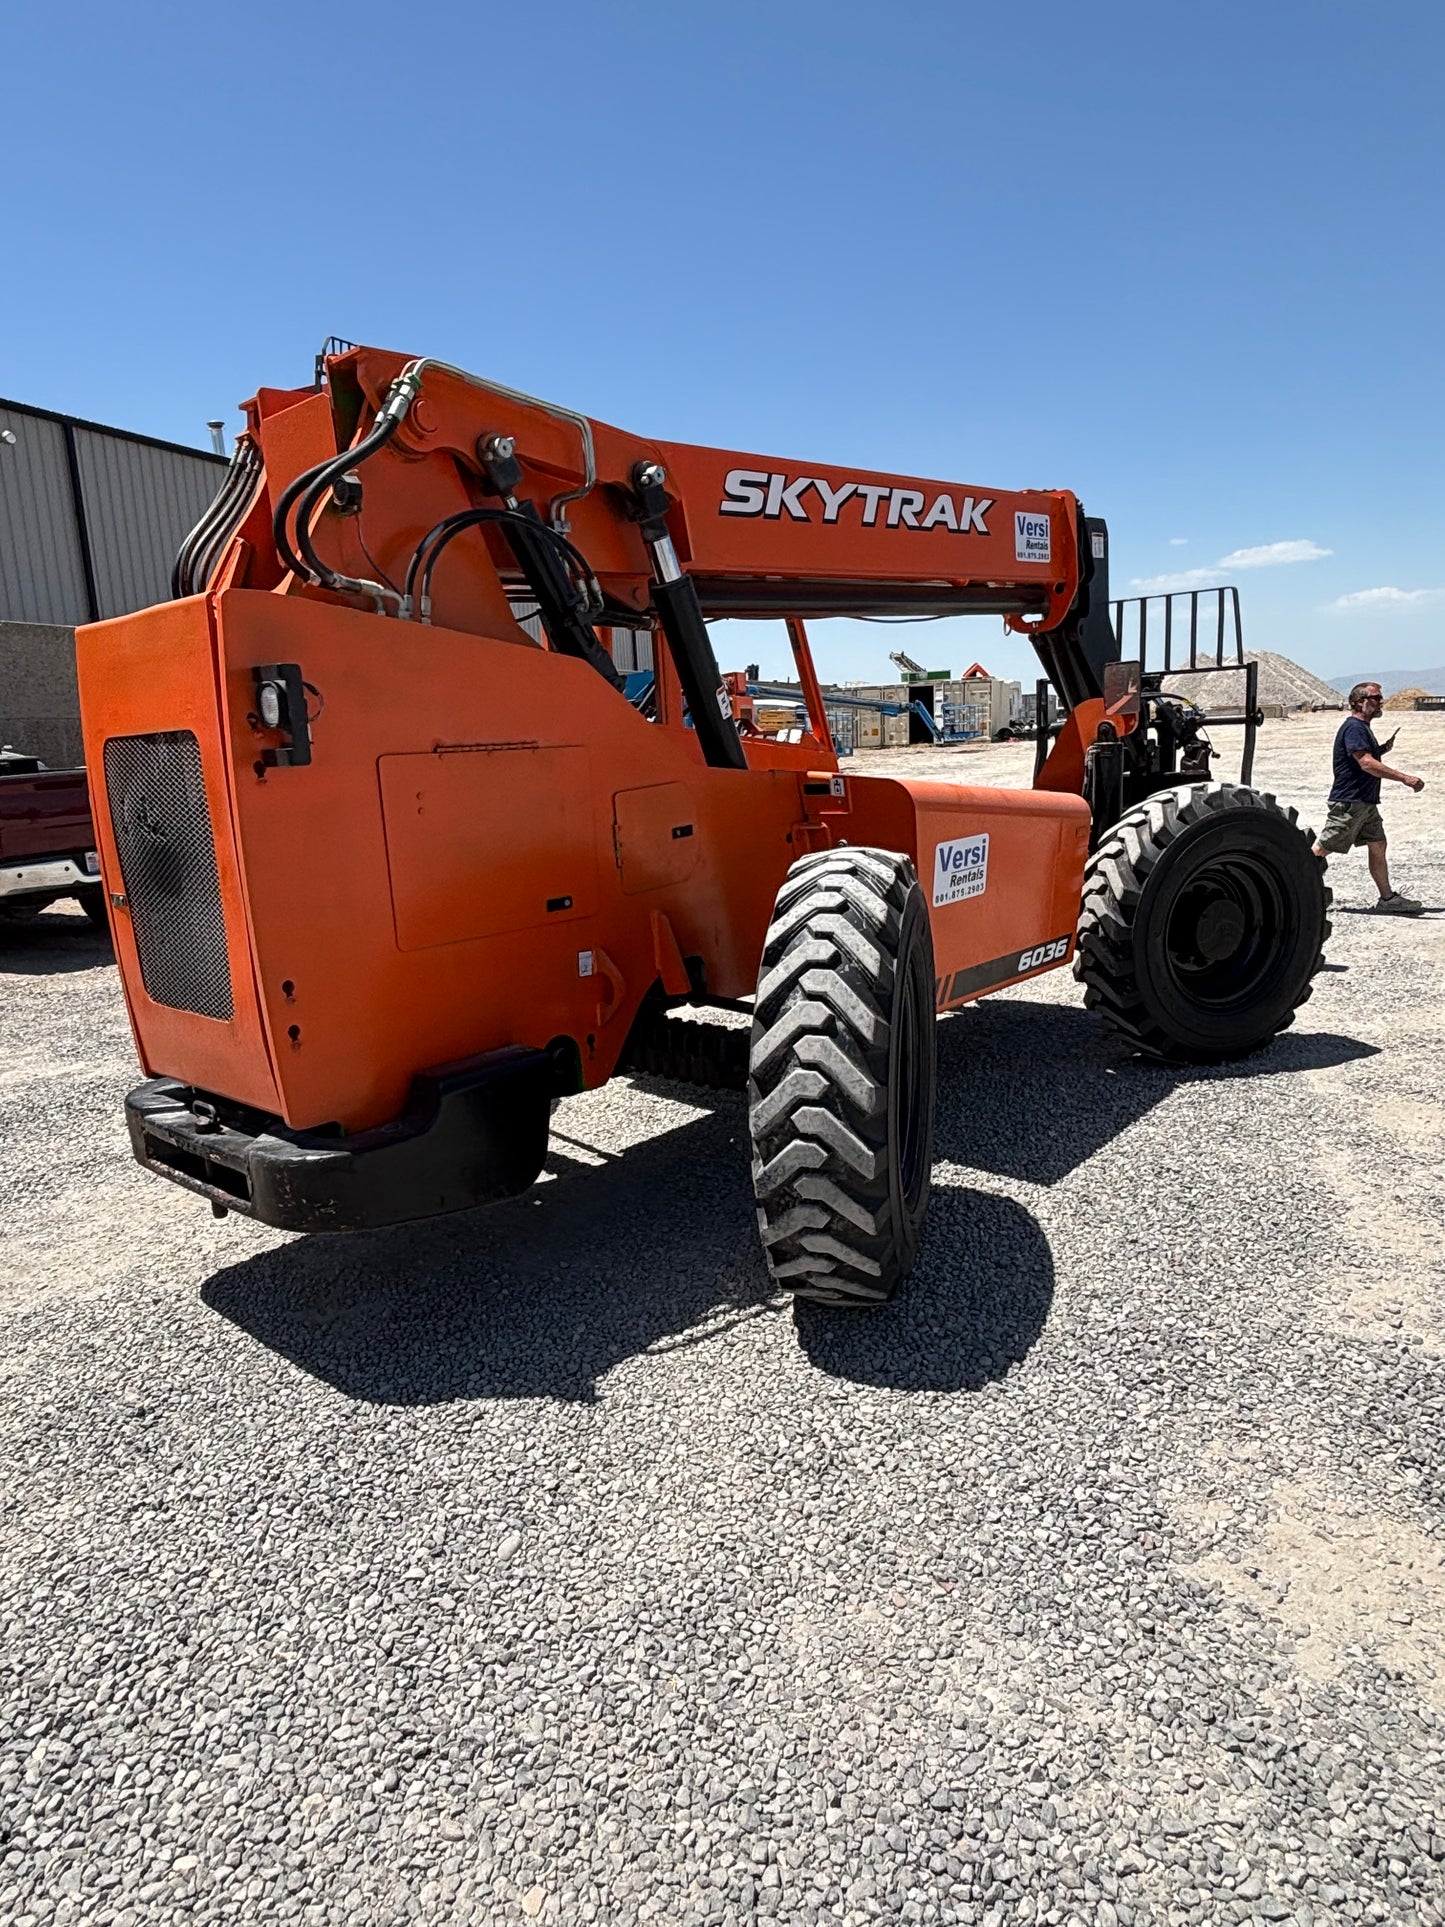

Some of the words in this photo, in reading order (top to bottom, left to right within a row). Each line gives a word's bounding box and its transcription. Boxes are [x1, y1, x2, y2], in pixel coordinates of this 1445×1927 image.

[719, 469, 997, 535] SKYTRAK
[1017, 515, 1048, 537] Versi
[1026, 540, 1048, 550] Rentals
[939, 838, 986, 872] Versi
[949, 868, 984, 887] Rentals
[935, 882, 984, 903] 801.875.2903
[1017, 938, 1069, 972] 6036
